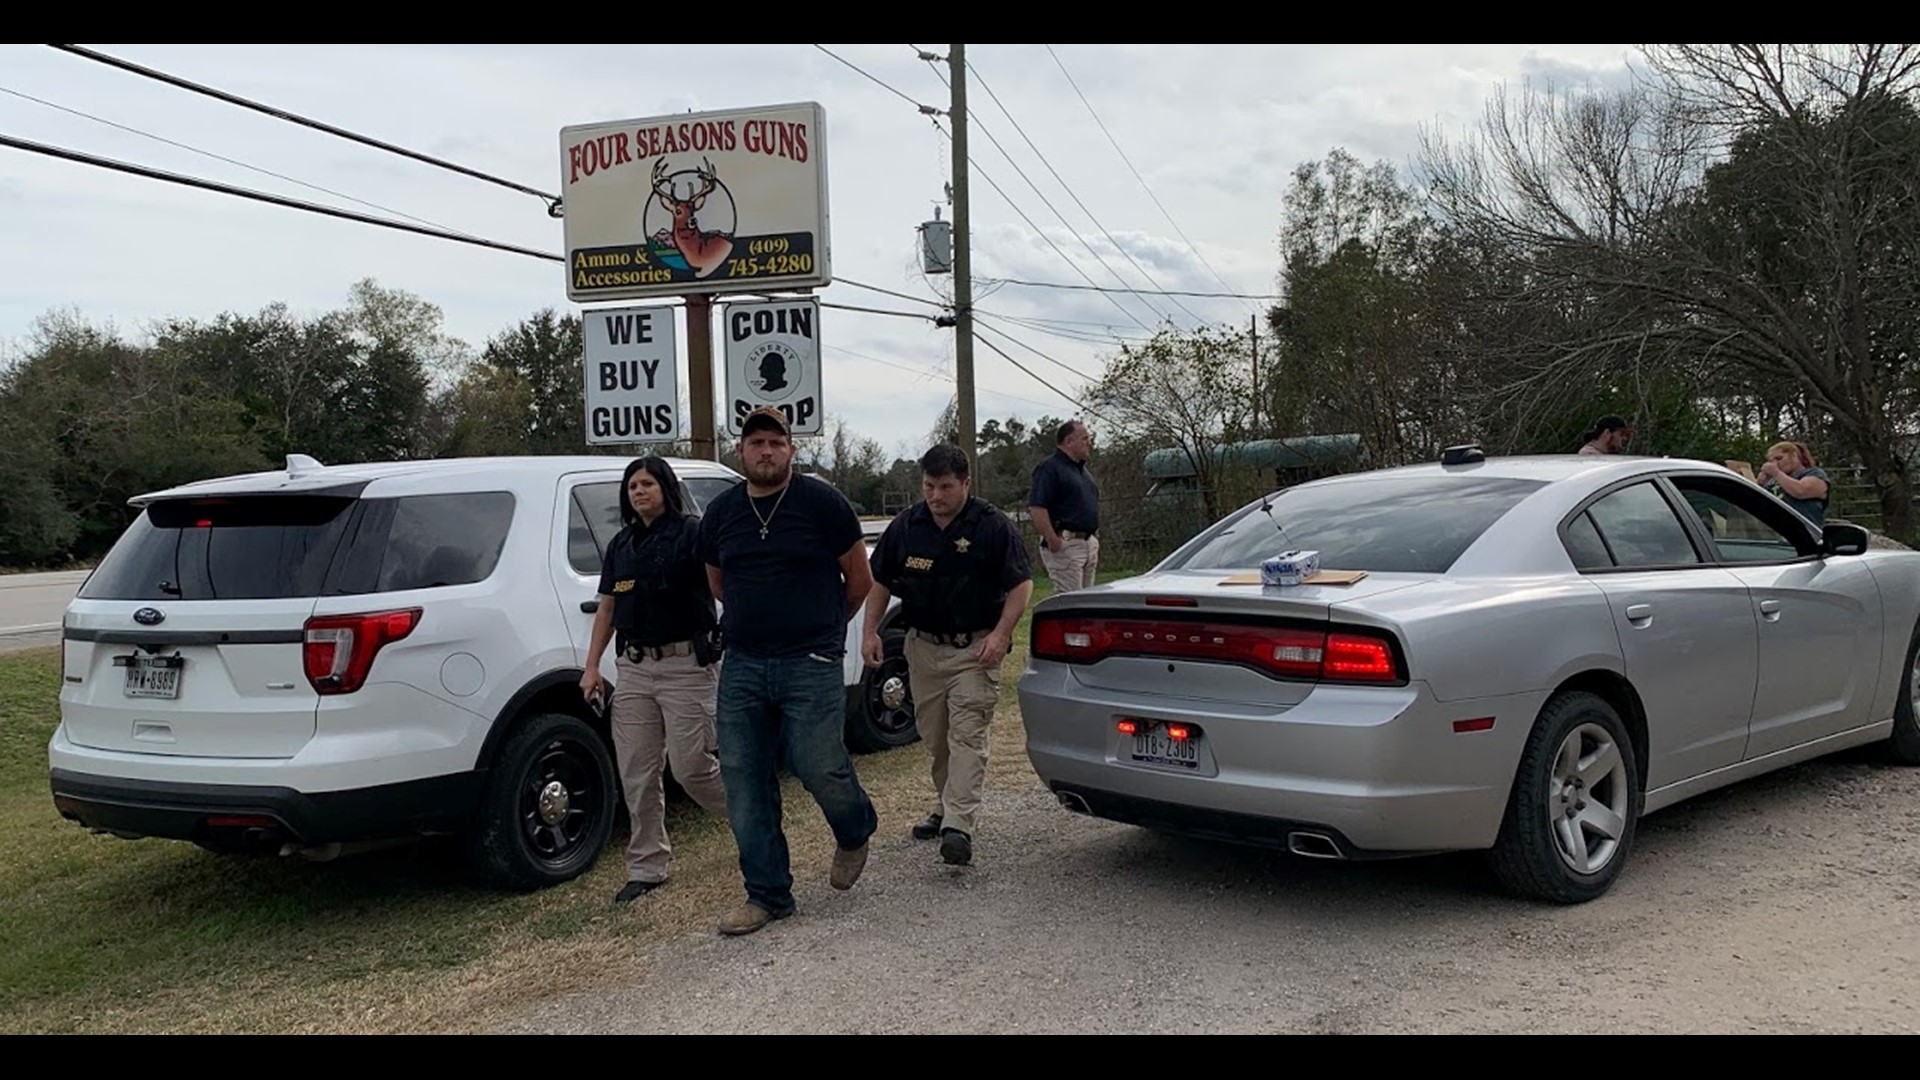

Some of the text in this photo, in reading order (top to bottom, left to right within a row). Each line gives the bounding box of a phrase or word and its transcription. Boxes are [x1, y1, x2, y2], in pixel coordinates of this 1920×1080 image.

[568, 120, 808, 185] FOUR SEASONS GUNS
[574, 247, 650, 269] Ammo &
[749, 236, 790, 256] (409)
[575, 265, 672, 287] Accessories
[728, 253, 812, 277] 745-4280
[605, 313, 653, 345] WE
[731, 307, 812, 342] COIN
[750, 344, 796, 362] LIBERTY
[599, 359, 660, 392] BUY
[592, 404, 672, 437] GUNS
[735, 396, 814, 428] SOP
[905, 556, 934, 570] SHERIFF
[1123, 632, 1224, 645] DODGE
